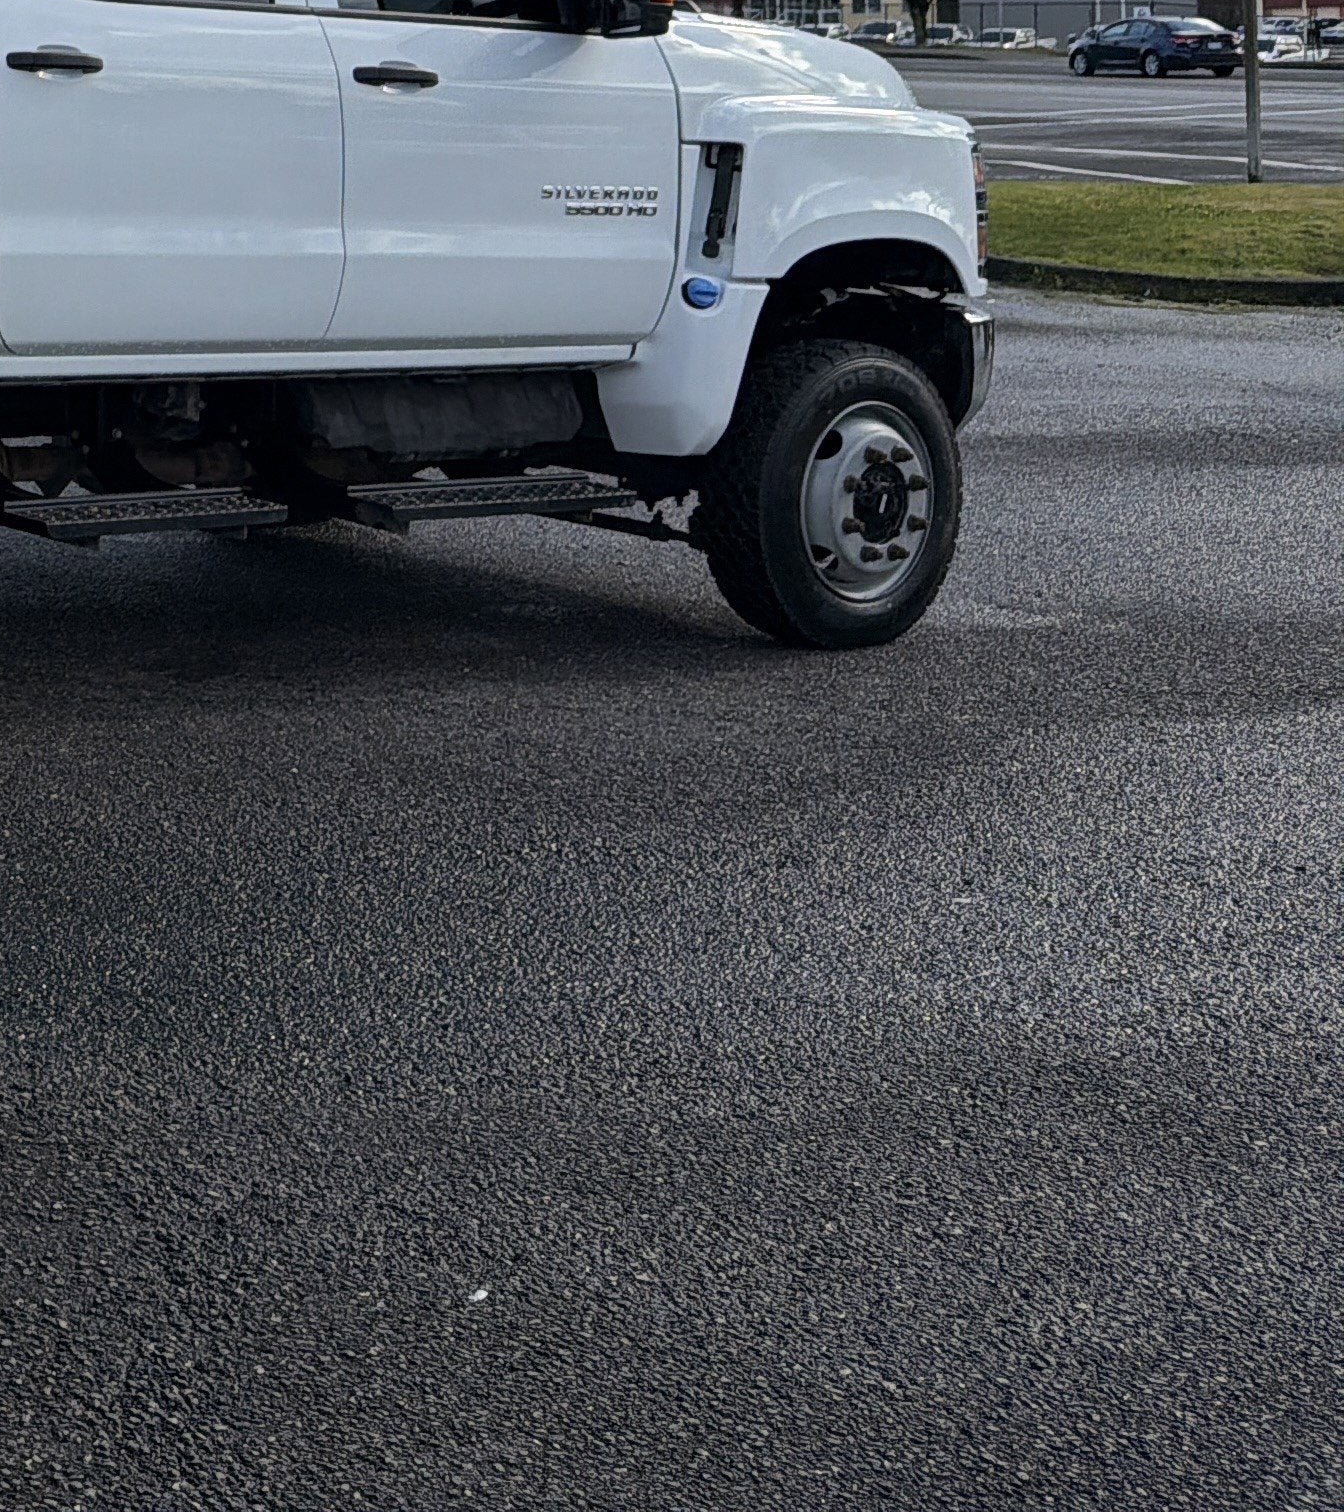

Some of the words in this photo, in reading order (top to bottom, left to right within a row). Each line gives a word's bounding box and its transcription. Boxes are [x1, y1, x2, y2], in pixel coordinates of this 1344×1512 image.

[541, 184, 659, 200] SILVERADO
[565, 202, 623, 216] 5500
[626, 203, 658, 217] HD
